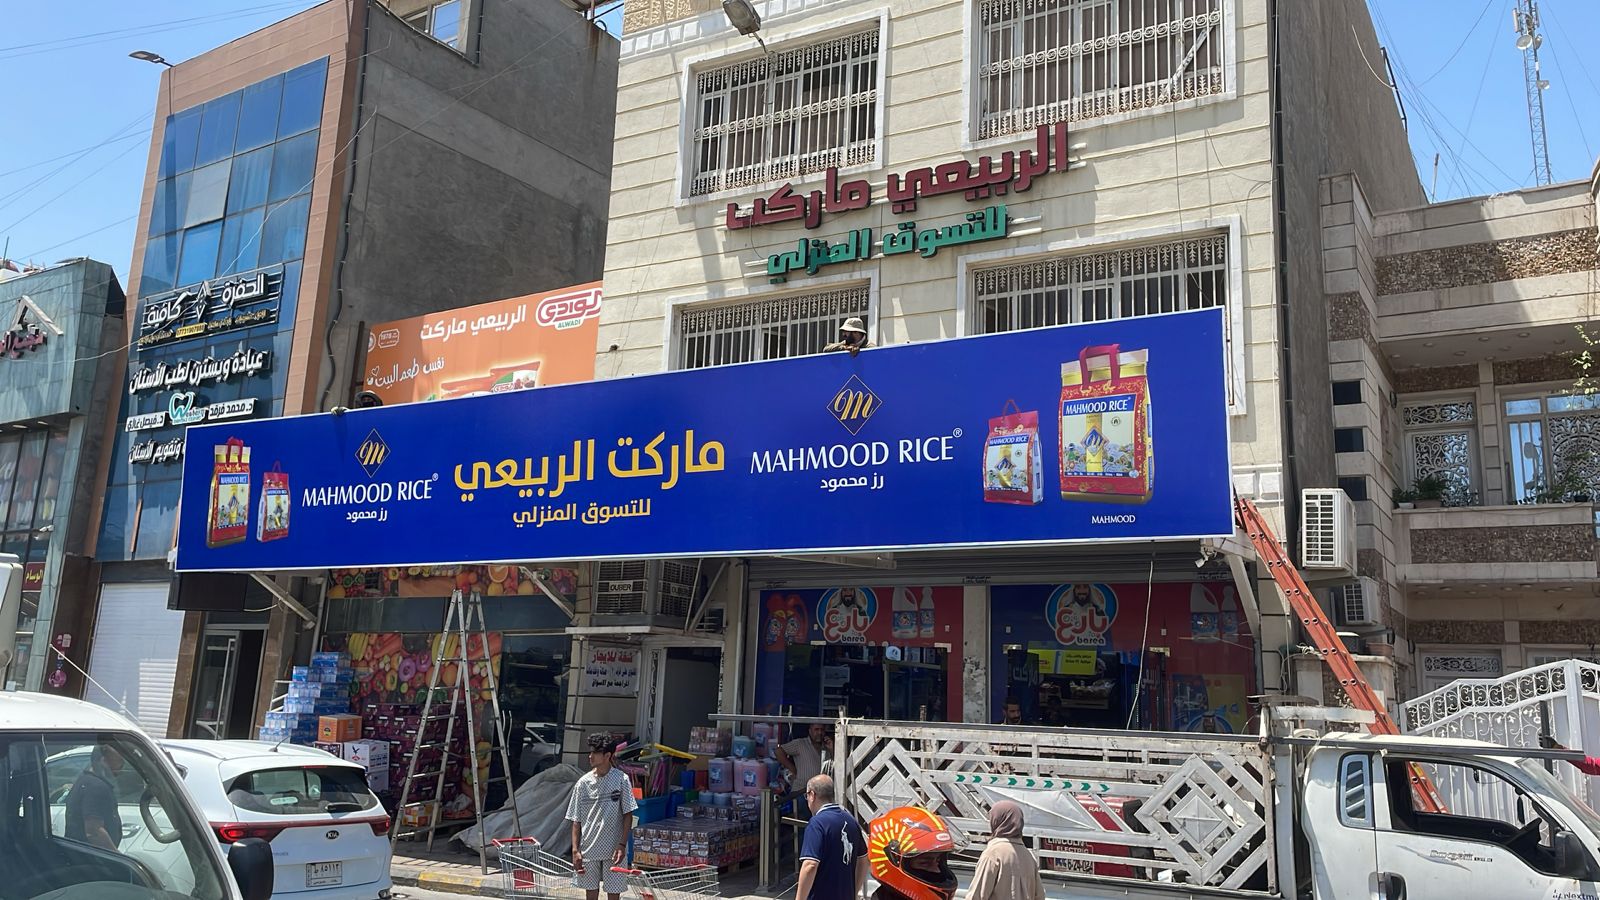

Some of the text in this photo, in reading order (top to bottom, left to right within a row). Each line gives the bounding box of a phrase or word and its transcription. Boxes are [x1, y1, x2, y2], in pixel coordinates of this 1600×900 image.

[887, 121, 1069, 214] الربيعي
[767, 204, 1008, 284] للتسوق المنزلي
[420, 304, 526, 342] الربيعي ماركت
[557, 319, 581, 329] ALWADI
[164, 360, 189, 390] لطب
[232, 349, 267, 376] عيادة
[373, 357, 445, 388] نفس طعم البيت
[129, 361, 166, 394] الأسنان
[225, 403, 245, 414] محمد
[1065, 399, 1128, 415] MAHMOOD RICE
[989, 437, 1015, 445] MAHMOOD
[454, 429, 725, 502] ماركت الربيعي
[750, 440, 889, 474] MAHMOOD
[302, 482, 392, 507] MAHMOOD
[820, 472, 884, 492] رز محمود
[346, 507, 388, 523] رز محمود
[513, 498, 651, 528] للتسوق المنزلي
[1091, 514, 1136, 524] MAHMOOD
[825, 609, 868, 642] بارع
[841, 634, 865, 642] barea
[1056, 608, 1107, 643] بارع
[1077, 636, 1105, 644] barea
[1088, 806, 1120, 814] RANR
[327, 831, 338, 840] KIA
